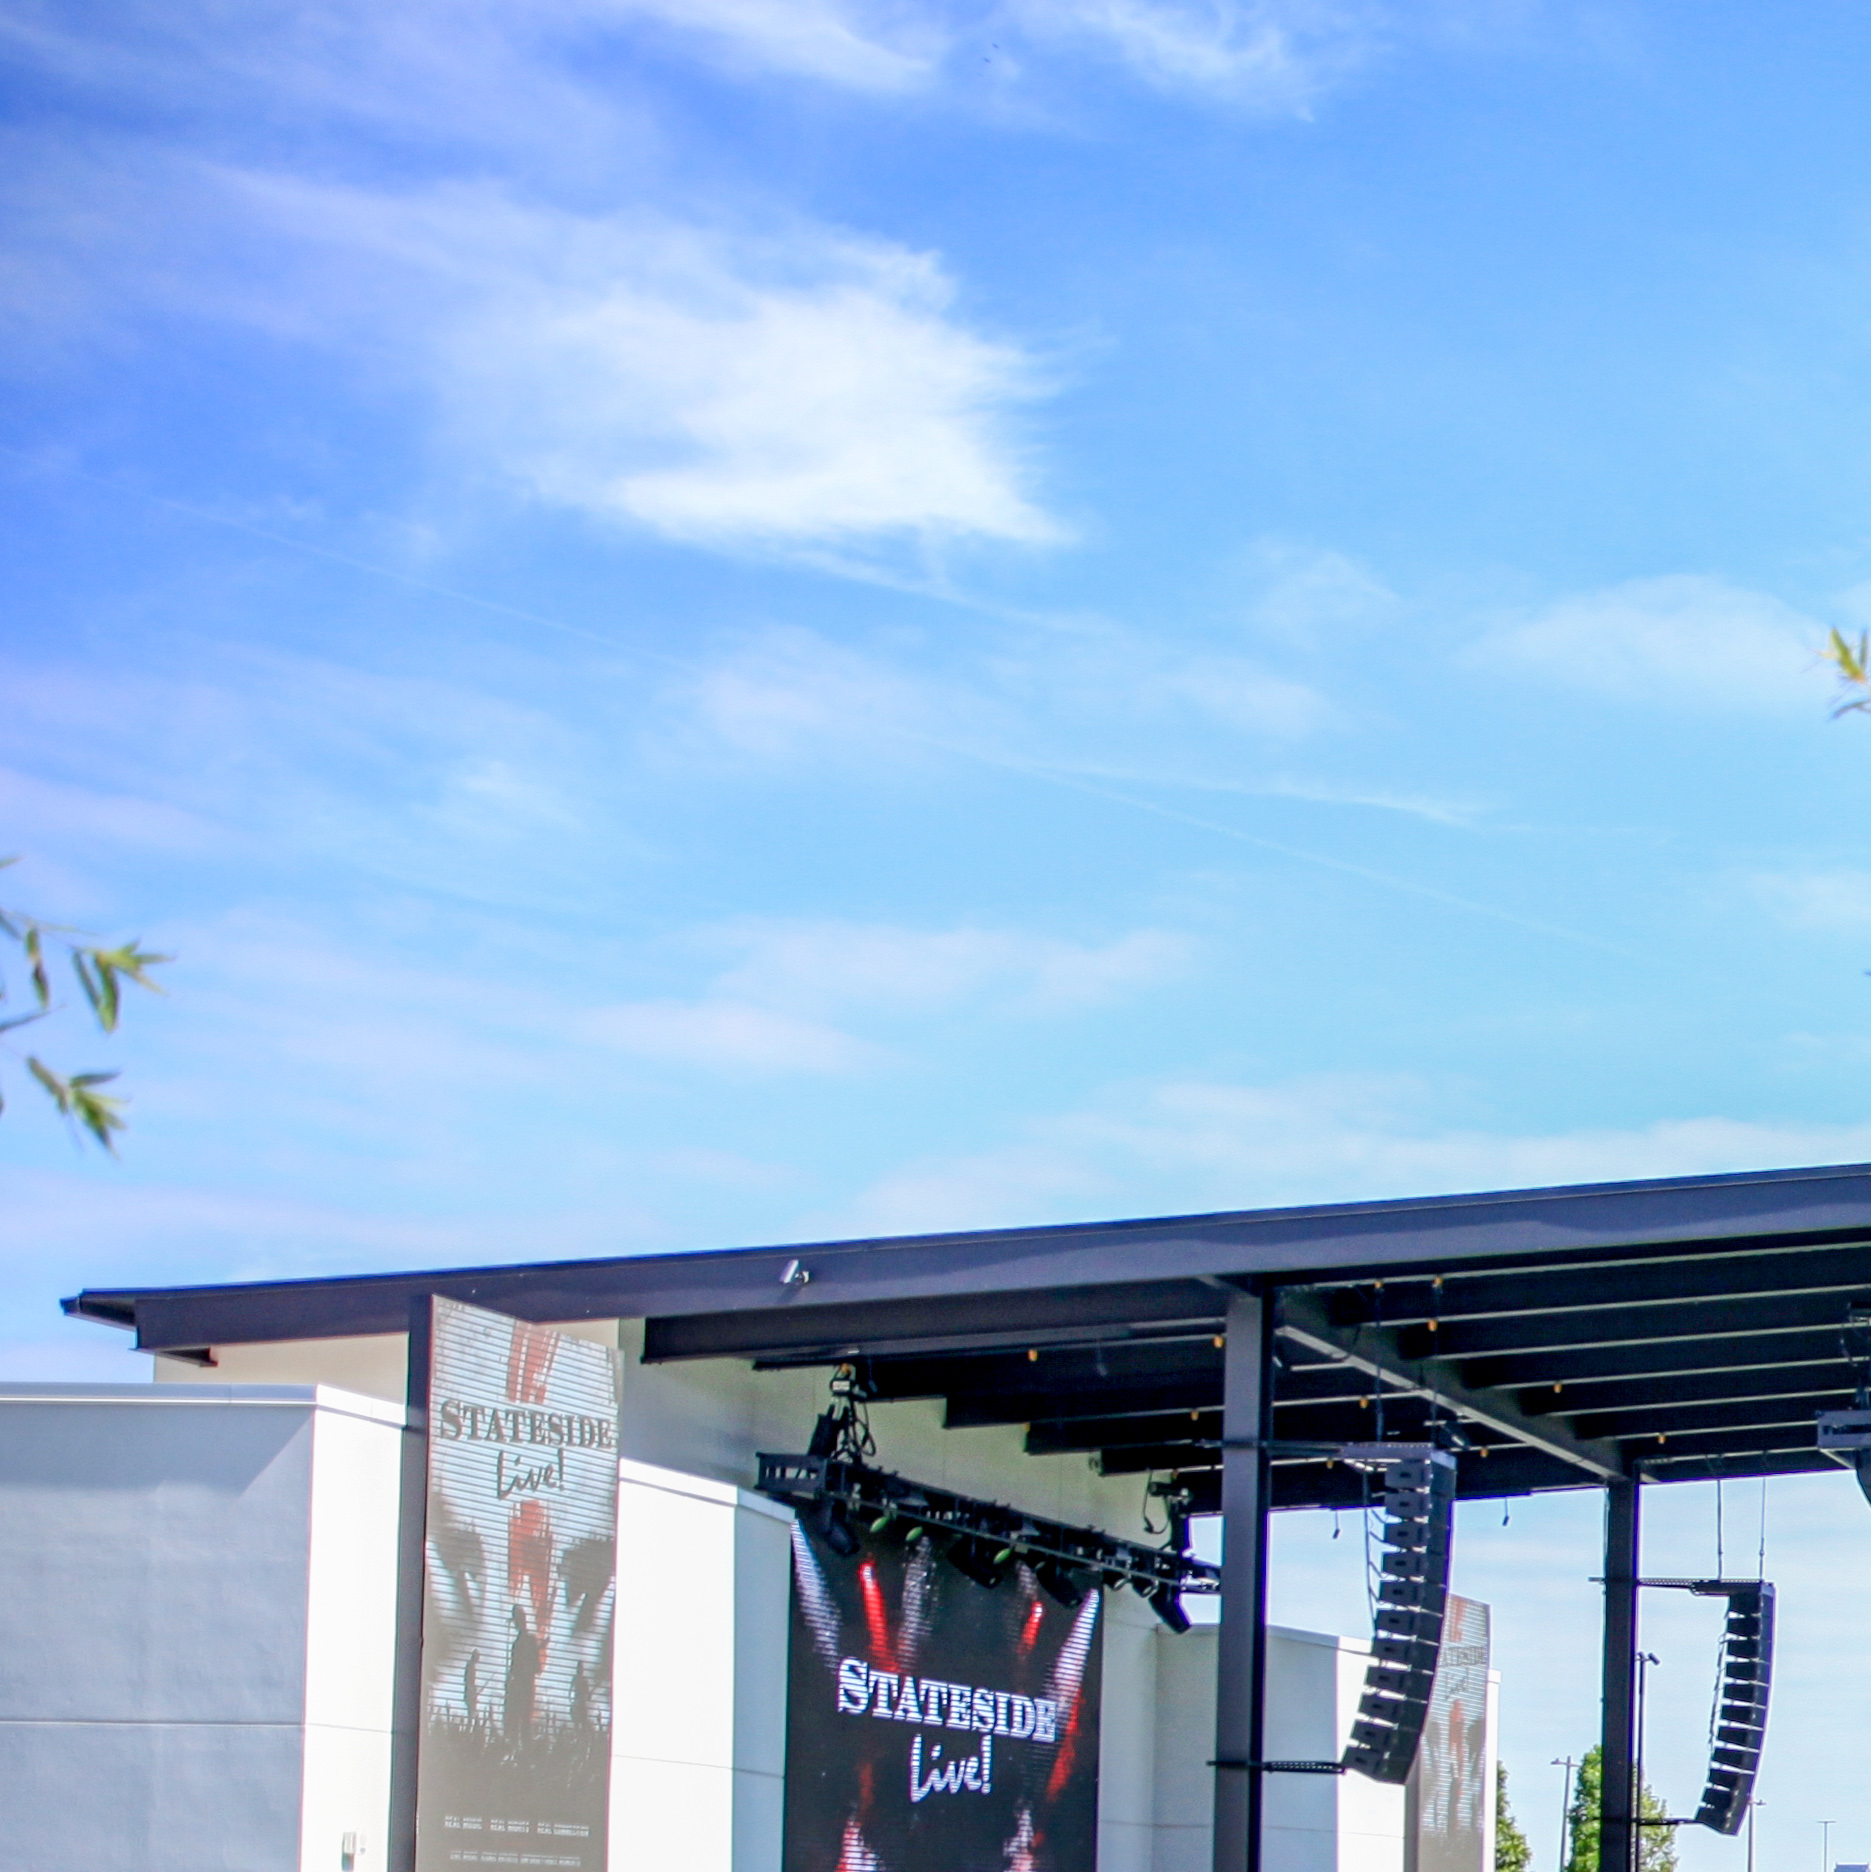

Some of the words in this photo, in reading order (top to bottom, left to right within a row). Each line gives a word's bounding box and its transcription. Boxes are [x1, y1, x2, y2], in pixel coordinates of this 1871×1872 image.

[441, 1399, 613, 1450] STATESIDE
[496, 1447, 565, 1500] Live!
[837, 1656, 1057, 1743] STATESIDE
[910, 1733, 993, 1803] Live!
